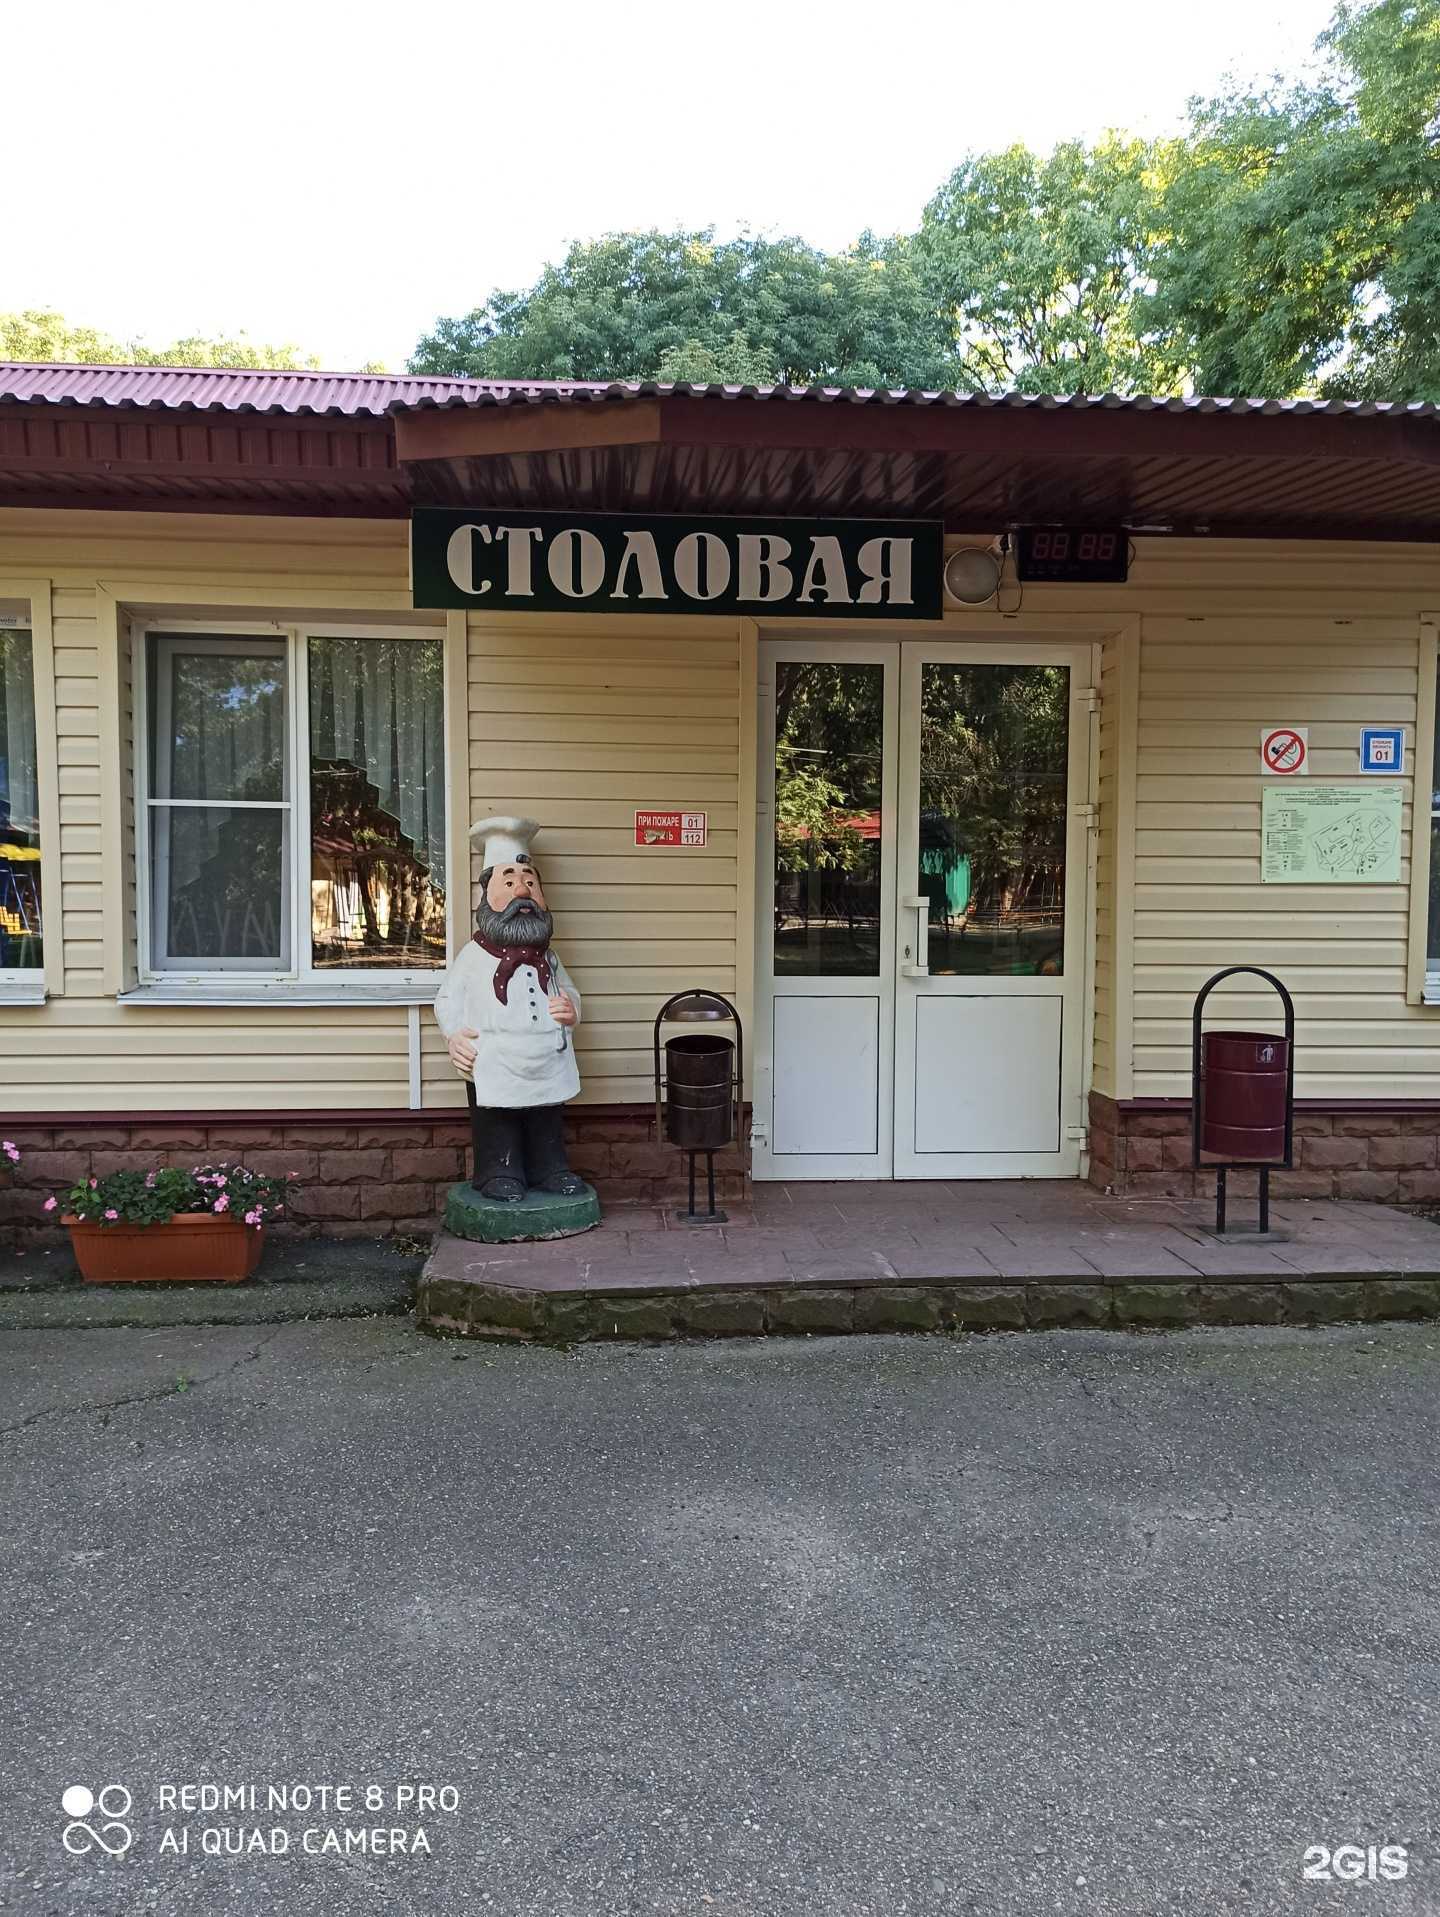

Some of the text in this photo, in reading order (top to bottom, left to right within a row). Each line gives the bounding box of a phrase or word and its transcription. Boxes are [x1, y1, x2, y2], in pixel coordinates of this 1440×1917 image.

[447, 524, 914, 604] СТОЛОВАЯ
[1375, 750, 1389, 761] 01
[638, 815, 680, 827] ПРИ ПОЖАРЕ
[688, 818, 699, 828] 01
[685, 834, 701, 844] 112
